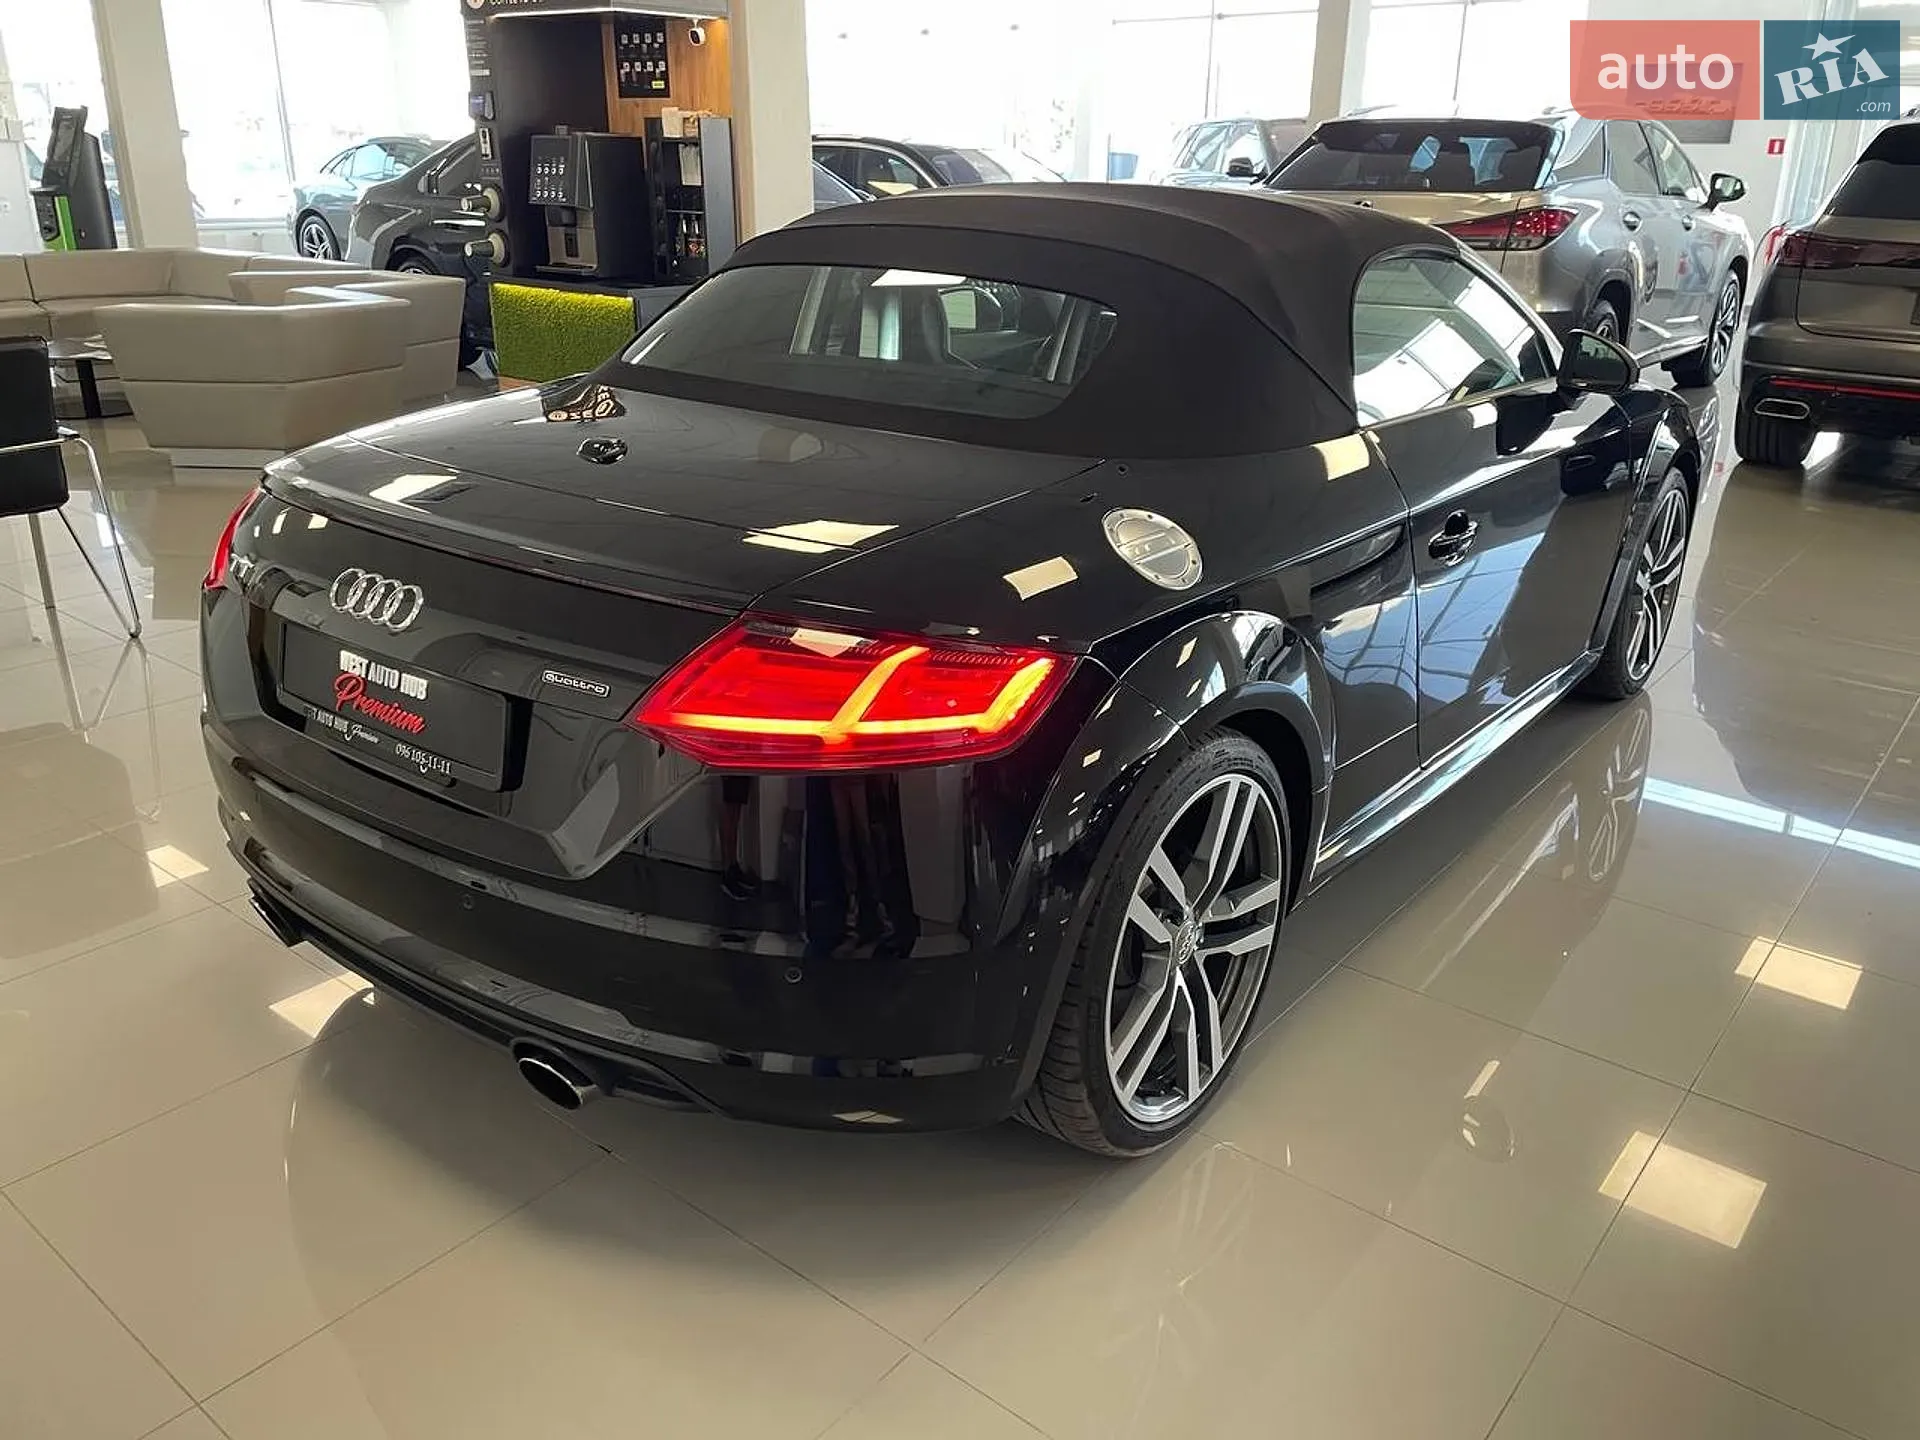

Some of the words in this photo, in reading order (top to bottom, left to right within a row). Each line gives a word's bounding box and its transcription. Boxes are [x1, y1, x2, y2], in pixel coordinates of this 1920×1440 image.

[340, 650, 369, 678] WEST
[368, 661, 400, 690] AUTO
[400, 672, 428, 700] HUB
[545, 673, 606, 694] quattro
[334, 672, 425, 734] Premium
